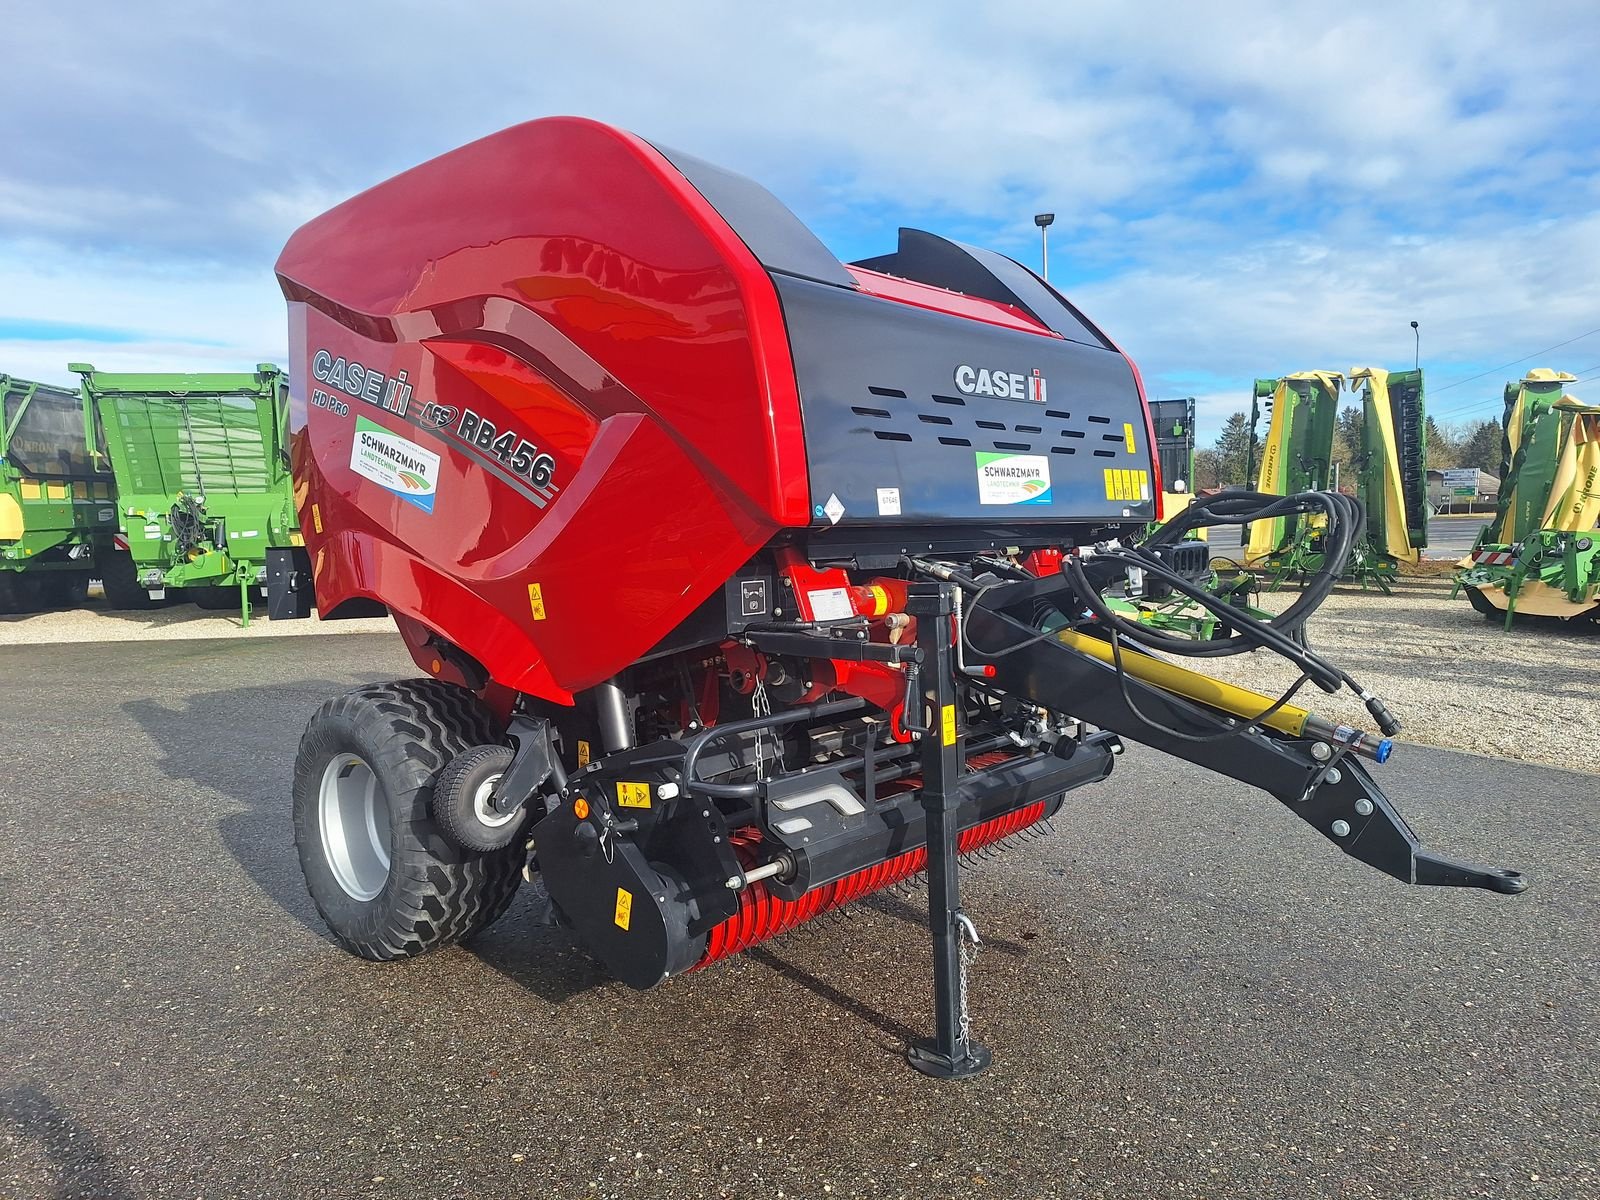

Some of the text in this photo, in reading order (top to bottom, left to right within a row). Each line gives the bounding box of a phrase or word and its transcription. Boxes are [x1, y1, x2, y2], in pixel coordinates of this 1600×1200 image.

[313, 350, 384, 404] CASE
[955, 364, 1025, 400] CASE
[311, 389, 327, 408] HD
[360, 448, 397, 473] LANDTECHNIK
[361, 433, 426, 476] SCHWARZMAYR
[420, 401, 450, 427] AFS
[457, 408, 556, 490] RB456
[984, 466, 1041, 478] SCHWARZMAYR
[1265, 455, 1274, 489] KRONE
[1581, 465, 1598, 503] KRONE
